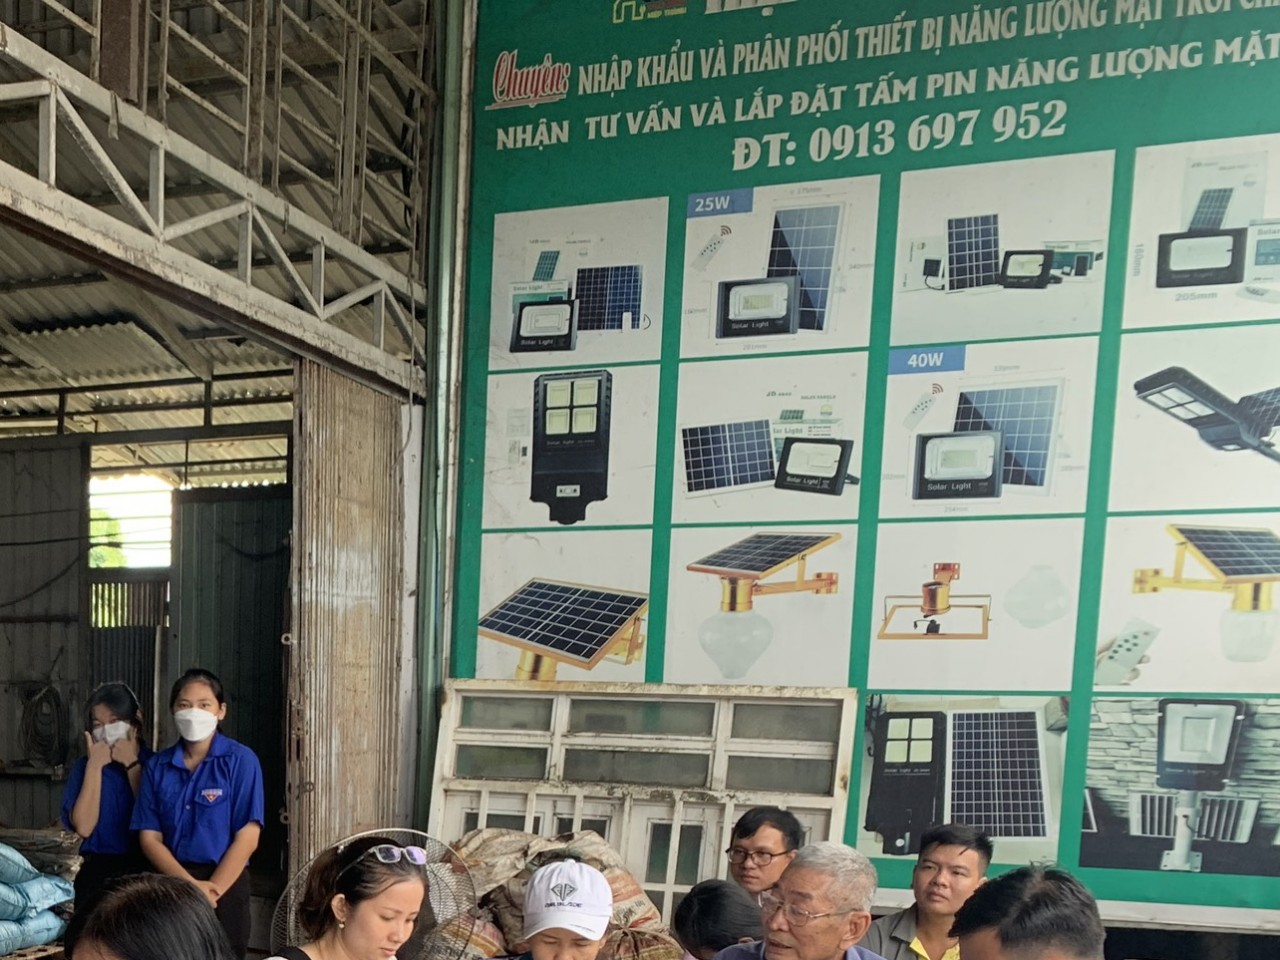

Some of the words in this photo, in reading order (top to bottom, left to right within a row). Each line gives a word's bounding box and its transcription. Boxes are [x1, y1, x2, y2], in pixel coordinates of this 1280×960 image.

[493, 49, 571, 107] Chuyên:
[578, 55, 632, 98] NHẬP
[637, 39, 694, 87] KHẨU
[700, 40, 727, 78] VÀ
[733, 33, 791, 75] PHÂN
[796, 20, 849, 66] PHỐI
[855, 10, 917, 58] THIẾT
[921, 16, 943, 55] BỊ
[949, 4, 1018, 46] NĂNG
[1024, 0, 1107, 39] LƯỢNG
[496, 118, 570, 150] NHẬN
[585, 112, 622, 140] TƯ
[626, 101, 682, 135] VẤN
[690, 96, 726, 127] VÀ
[734, 86, 783, 122] LẮP
[790, 83, 847, 117] ĐẶT
[854, 72, 918, 106] TẤM
[926, 69, 978, 99] PIN
[987, 57, 1079, 92] NĂNG
[1089, 42, 1203, 79] LƯỢNG
[1214, 30, 1280, 67] MẶT
[732, 132, 797, 170] ĐT:
[809, 119, 896, 162] 0913
[908, 109, 980, 151] 697
[992, 99, 1067, 143] 952
[695, 195, 731, 212] 25W
[1175, 291, 1218, 302] 205mm
[538, 338, 554, 347] Light
[907, 351, 944, 369] 40W
[773, 427, 783, 435] lar
[786, 475, 801, 483] Solar
[803, 477, 819, 486] Light
[927, 483, 947, 491] Solar
[951, 481, 971, 491] Light
